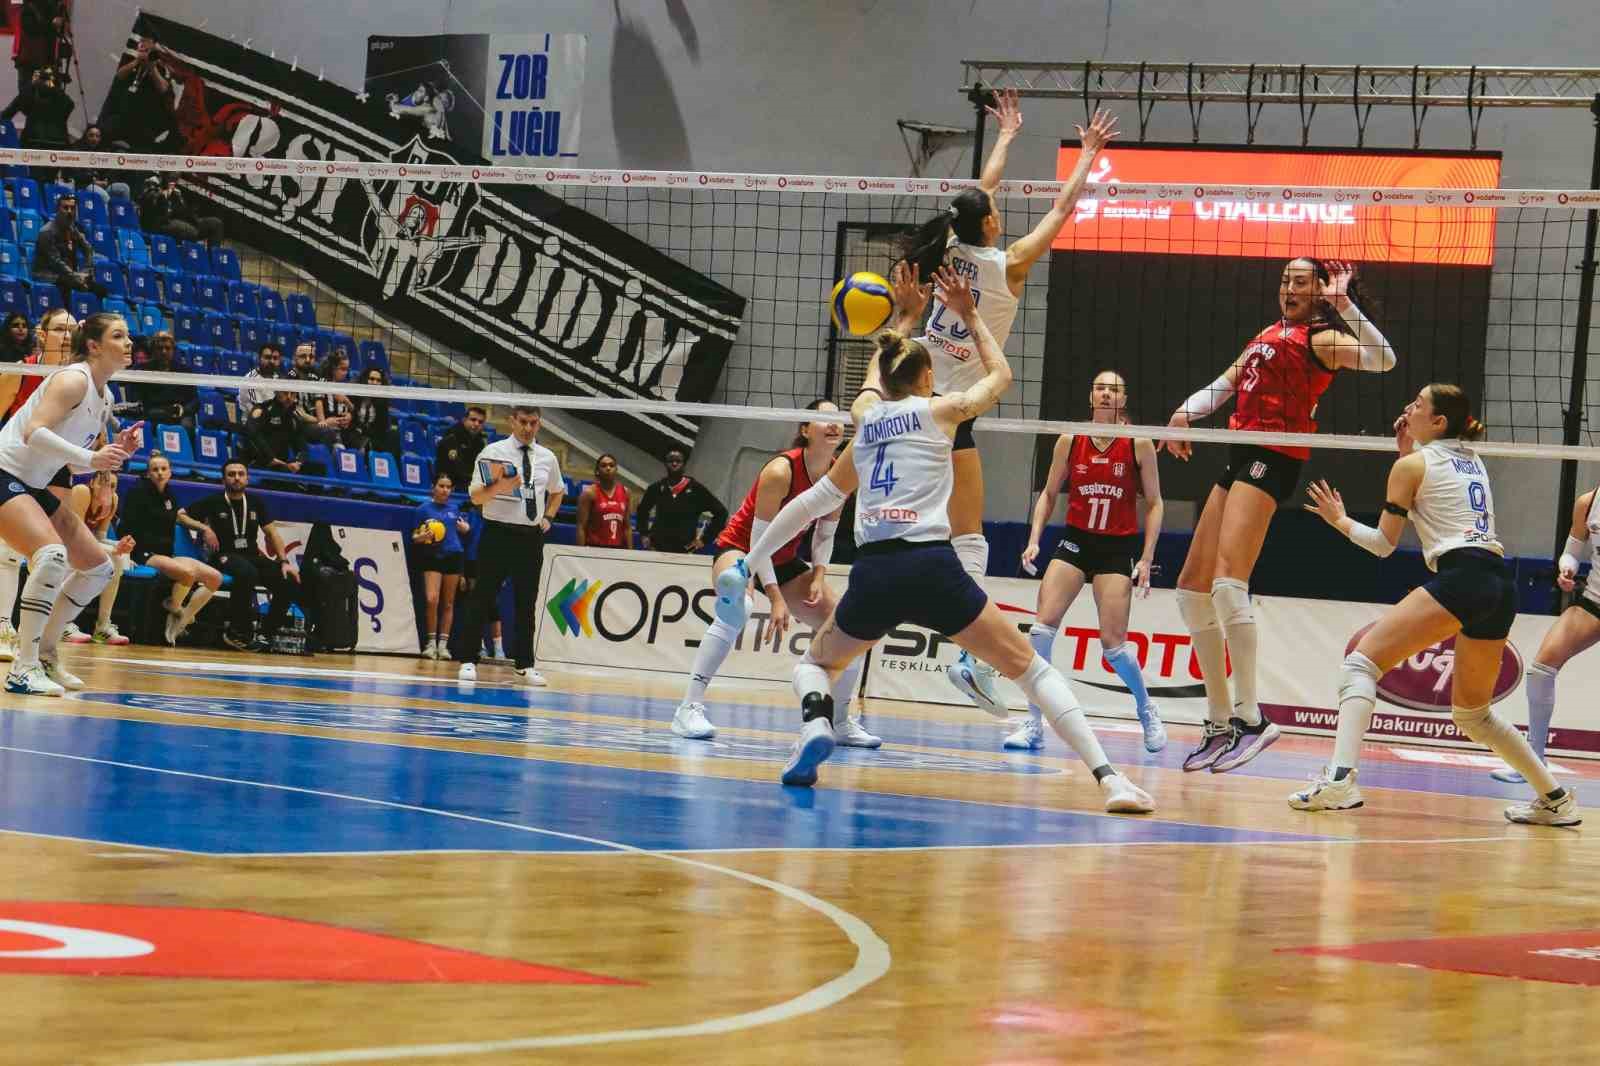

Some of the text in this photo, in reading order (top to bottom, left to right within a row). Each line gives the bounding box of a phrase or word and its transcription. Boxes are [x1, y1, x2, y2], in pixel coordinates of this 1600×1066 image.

[496, 54, 548, 100] ZOR
[1195, 200, 1355, 224] CHALLENGE
[870, 442, 899, 497] 4
[1088, 497, 1111, 530] 11
[1468, 481, 1489, 533] 9
